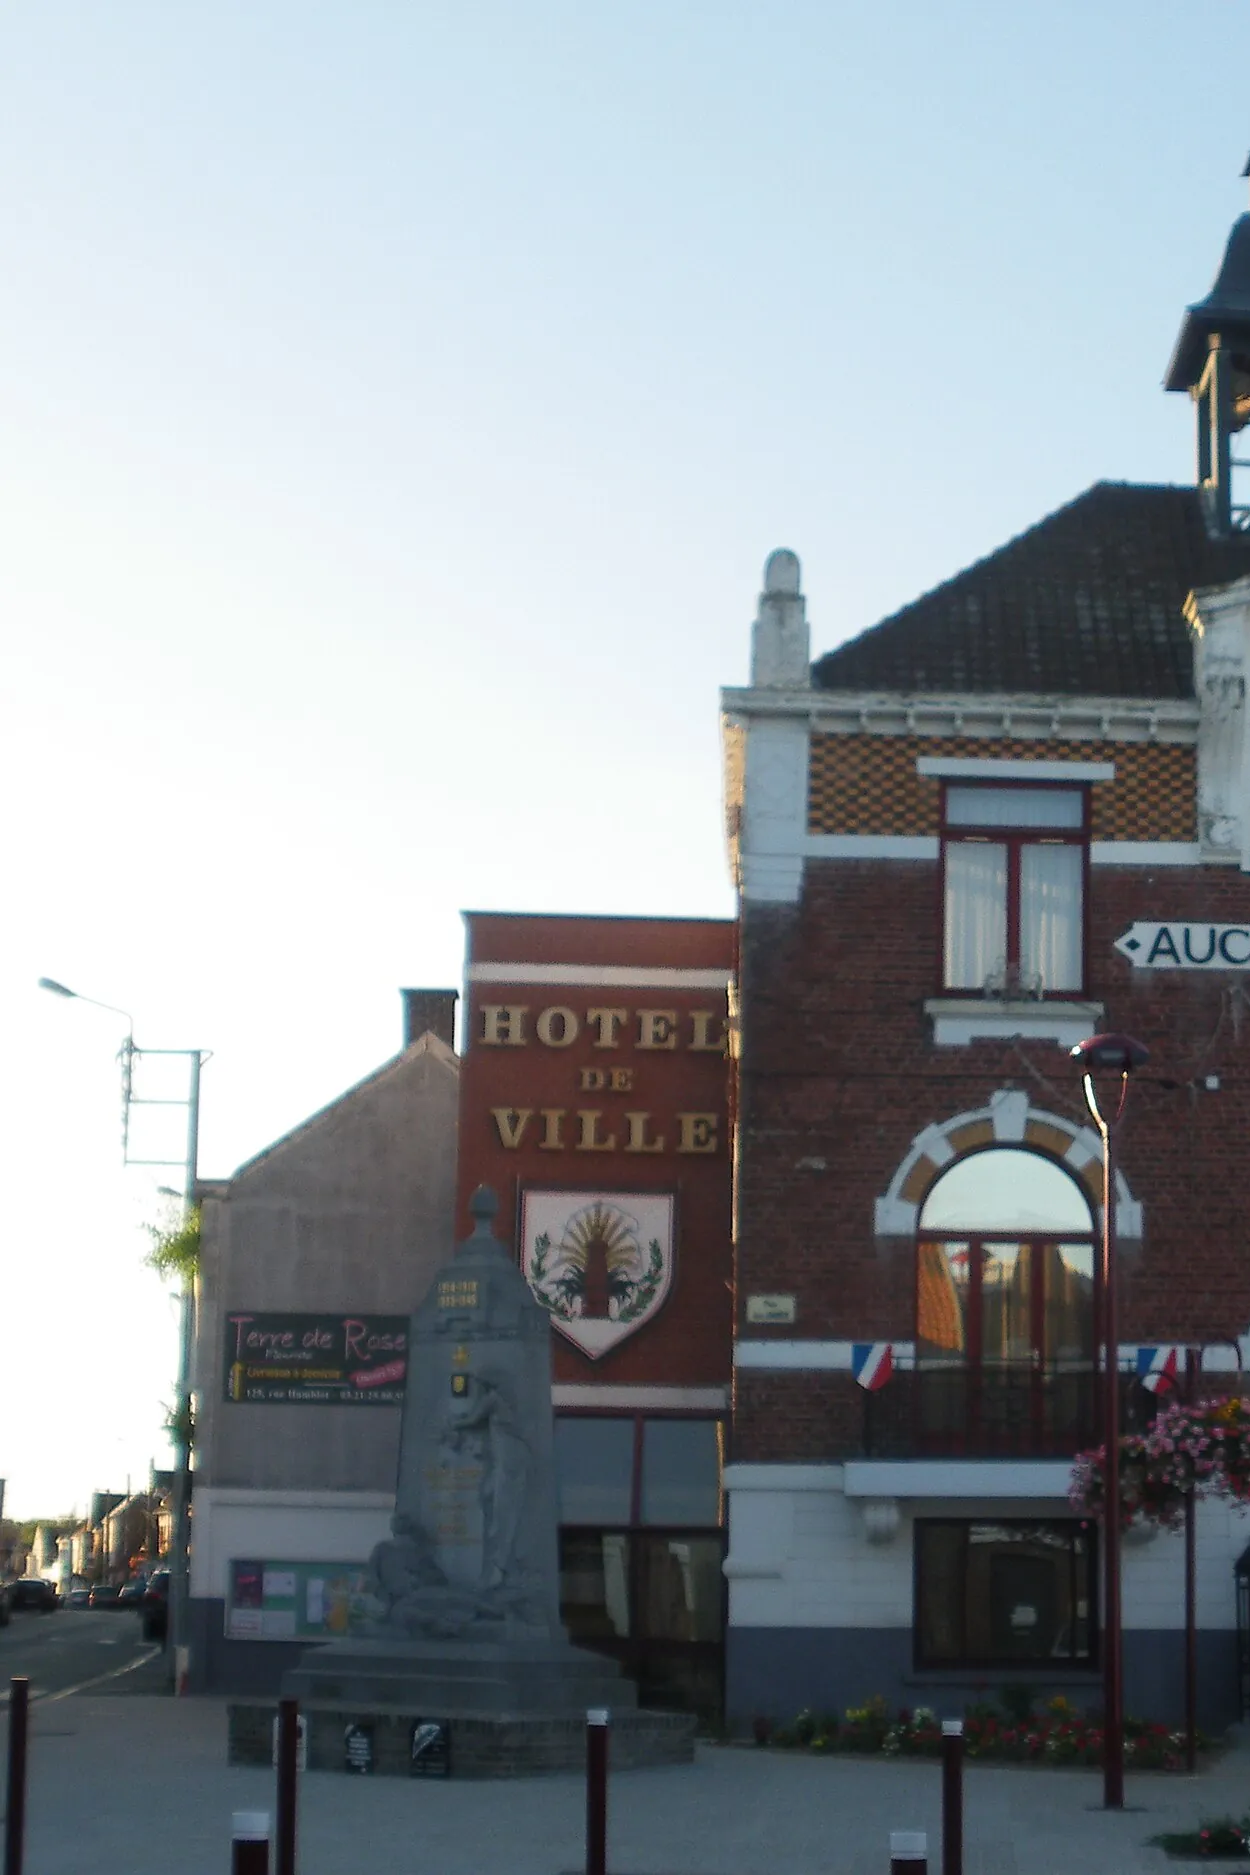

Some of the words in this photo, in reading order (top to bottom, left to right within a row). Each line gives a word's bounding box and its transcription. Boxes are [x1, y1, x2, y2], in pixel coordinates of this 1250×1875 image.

[477, 1003, 728, 1050] HOTEL
[579, 1067, 634, 1092] DE
[490, 1107, 720, 1154] VILLE
[229, 1316, 294, 1359] Terre
[302, 1327, 333, 1349] de
[342, 1319, 406, 1361] Rose
